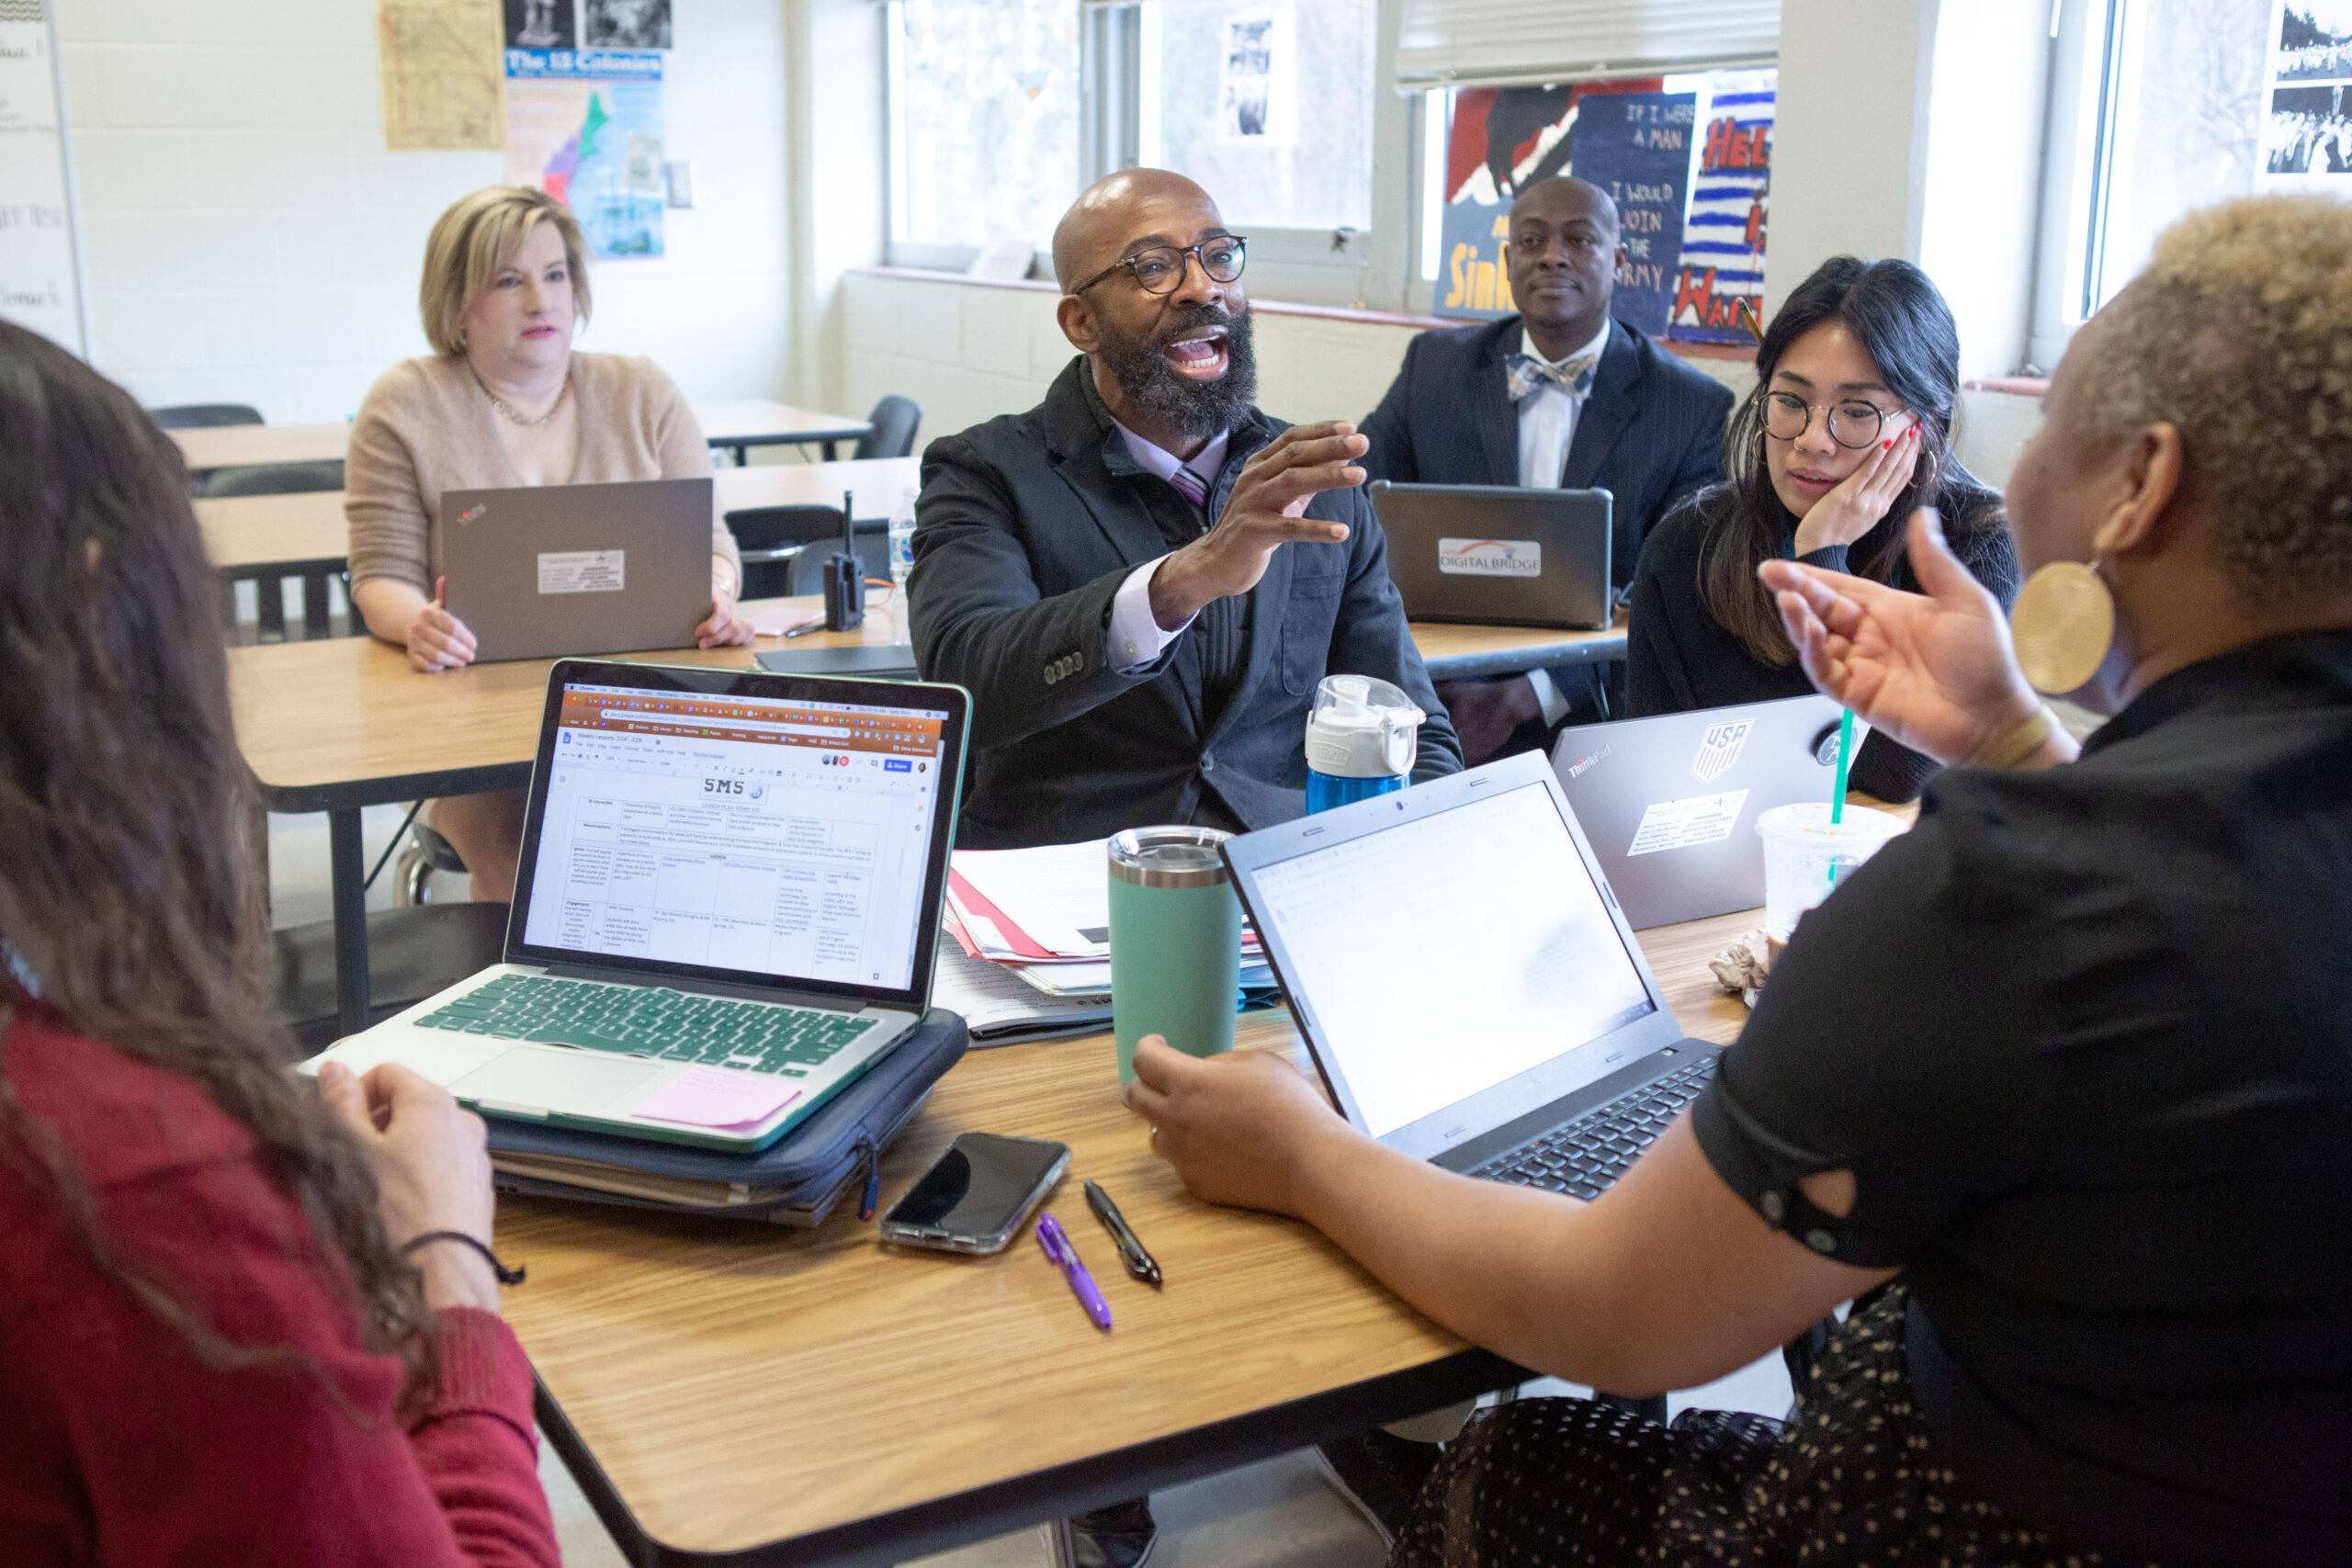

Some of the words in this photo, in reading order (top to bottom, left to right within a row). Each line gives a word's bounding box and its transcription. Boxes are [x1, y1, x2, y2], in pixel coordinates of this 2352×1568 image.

[508, 50, 547, 69] The
[575, 51, 661, 72] Colonies
[1626, 104, 1645, 121] IF
[1649, 105, 1659, 123] I
[1664, 104, 1696, 124] WERE
[1633, 129, 1645, 146] A
[1648, 130, 1682, 150] MAN
[1611, 181, 1622, 200] I
[1625, 182, 1673, 201] WOULD
[1629, 237, 1650, 259] THE
[1617, 262, 1664, 292] RMY
[1706, 724, 1747, 750] USA
[1567, 743, 1612, 778] ThinkPad
[703, 778, 744, 794] SMS
